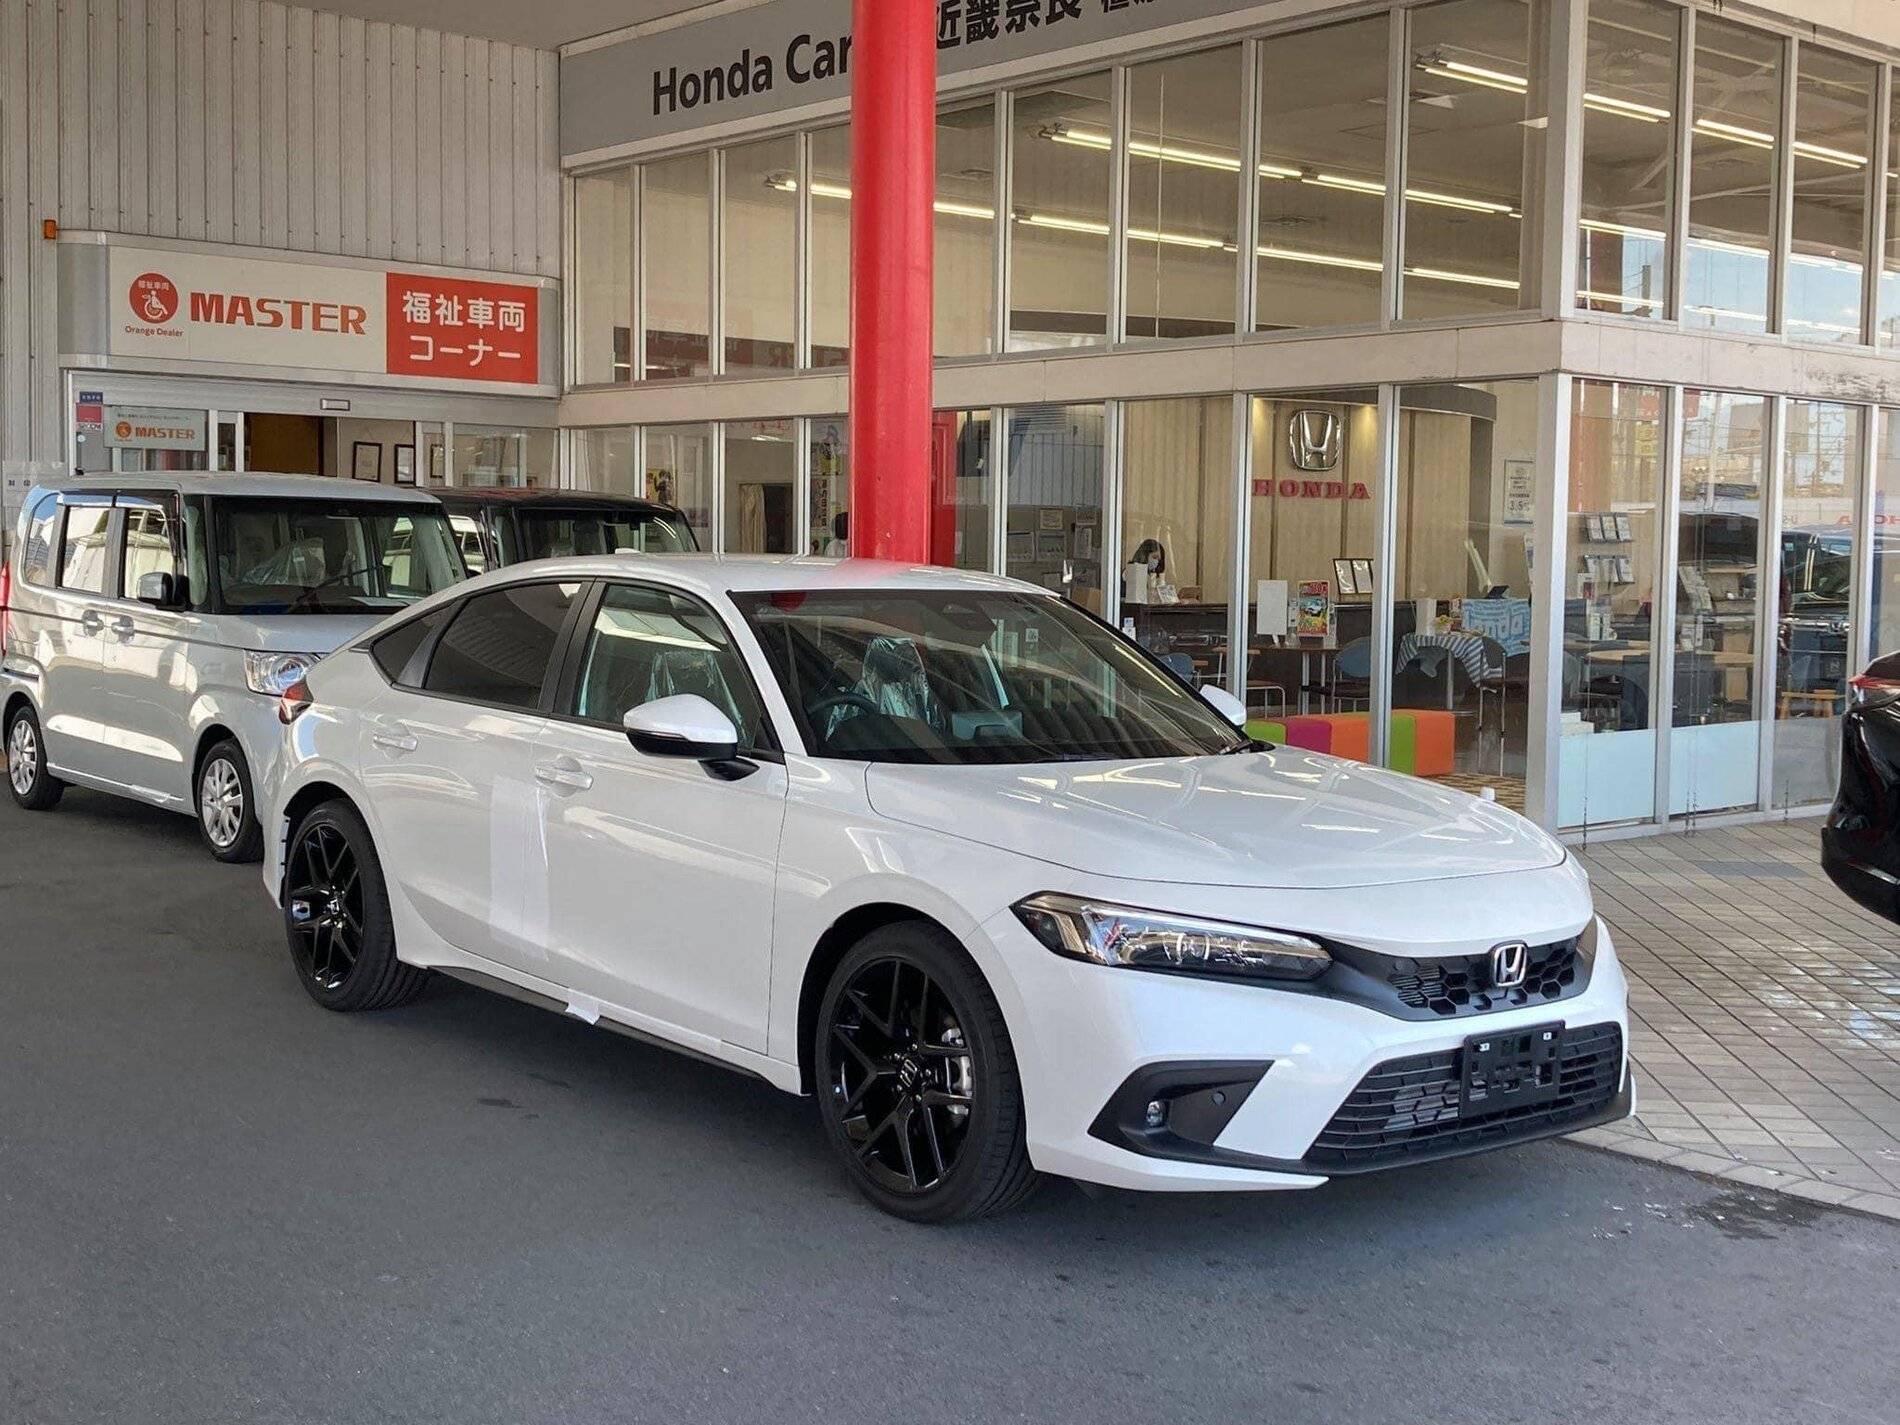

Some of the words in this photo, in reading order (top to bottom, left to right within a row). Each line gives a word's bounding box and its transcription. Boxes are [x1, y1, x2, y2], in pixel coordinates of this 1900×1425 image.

[653, 48, 773, 115] Honda
[190, 292, 367, 335] MASTER
[402, 290, 526, 333] 福祉車両
[124, 325, 155, 337] Orange
[156, 326, 184, 338] Dealer
[409, 334, 521, 367] コーナー
[135, 426, 195, 440] MASTER
[1252, 479, 1371, 500] HONDA
